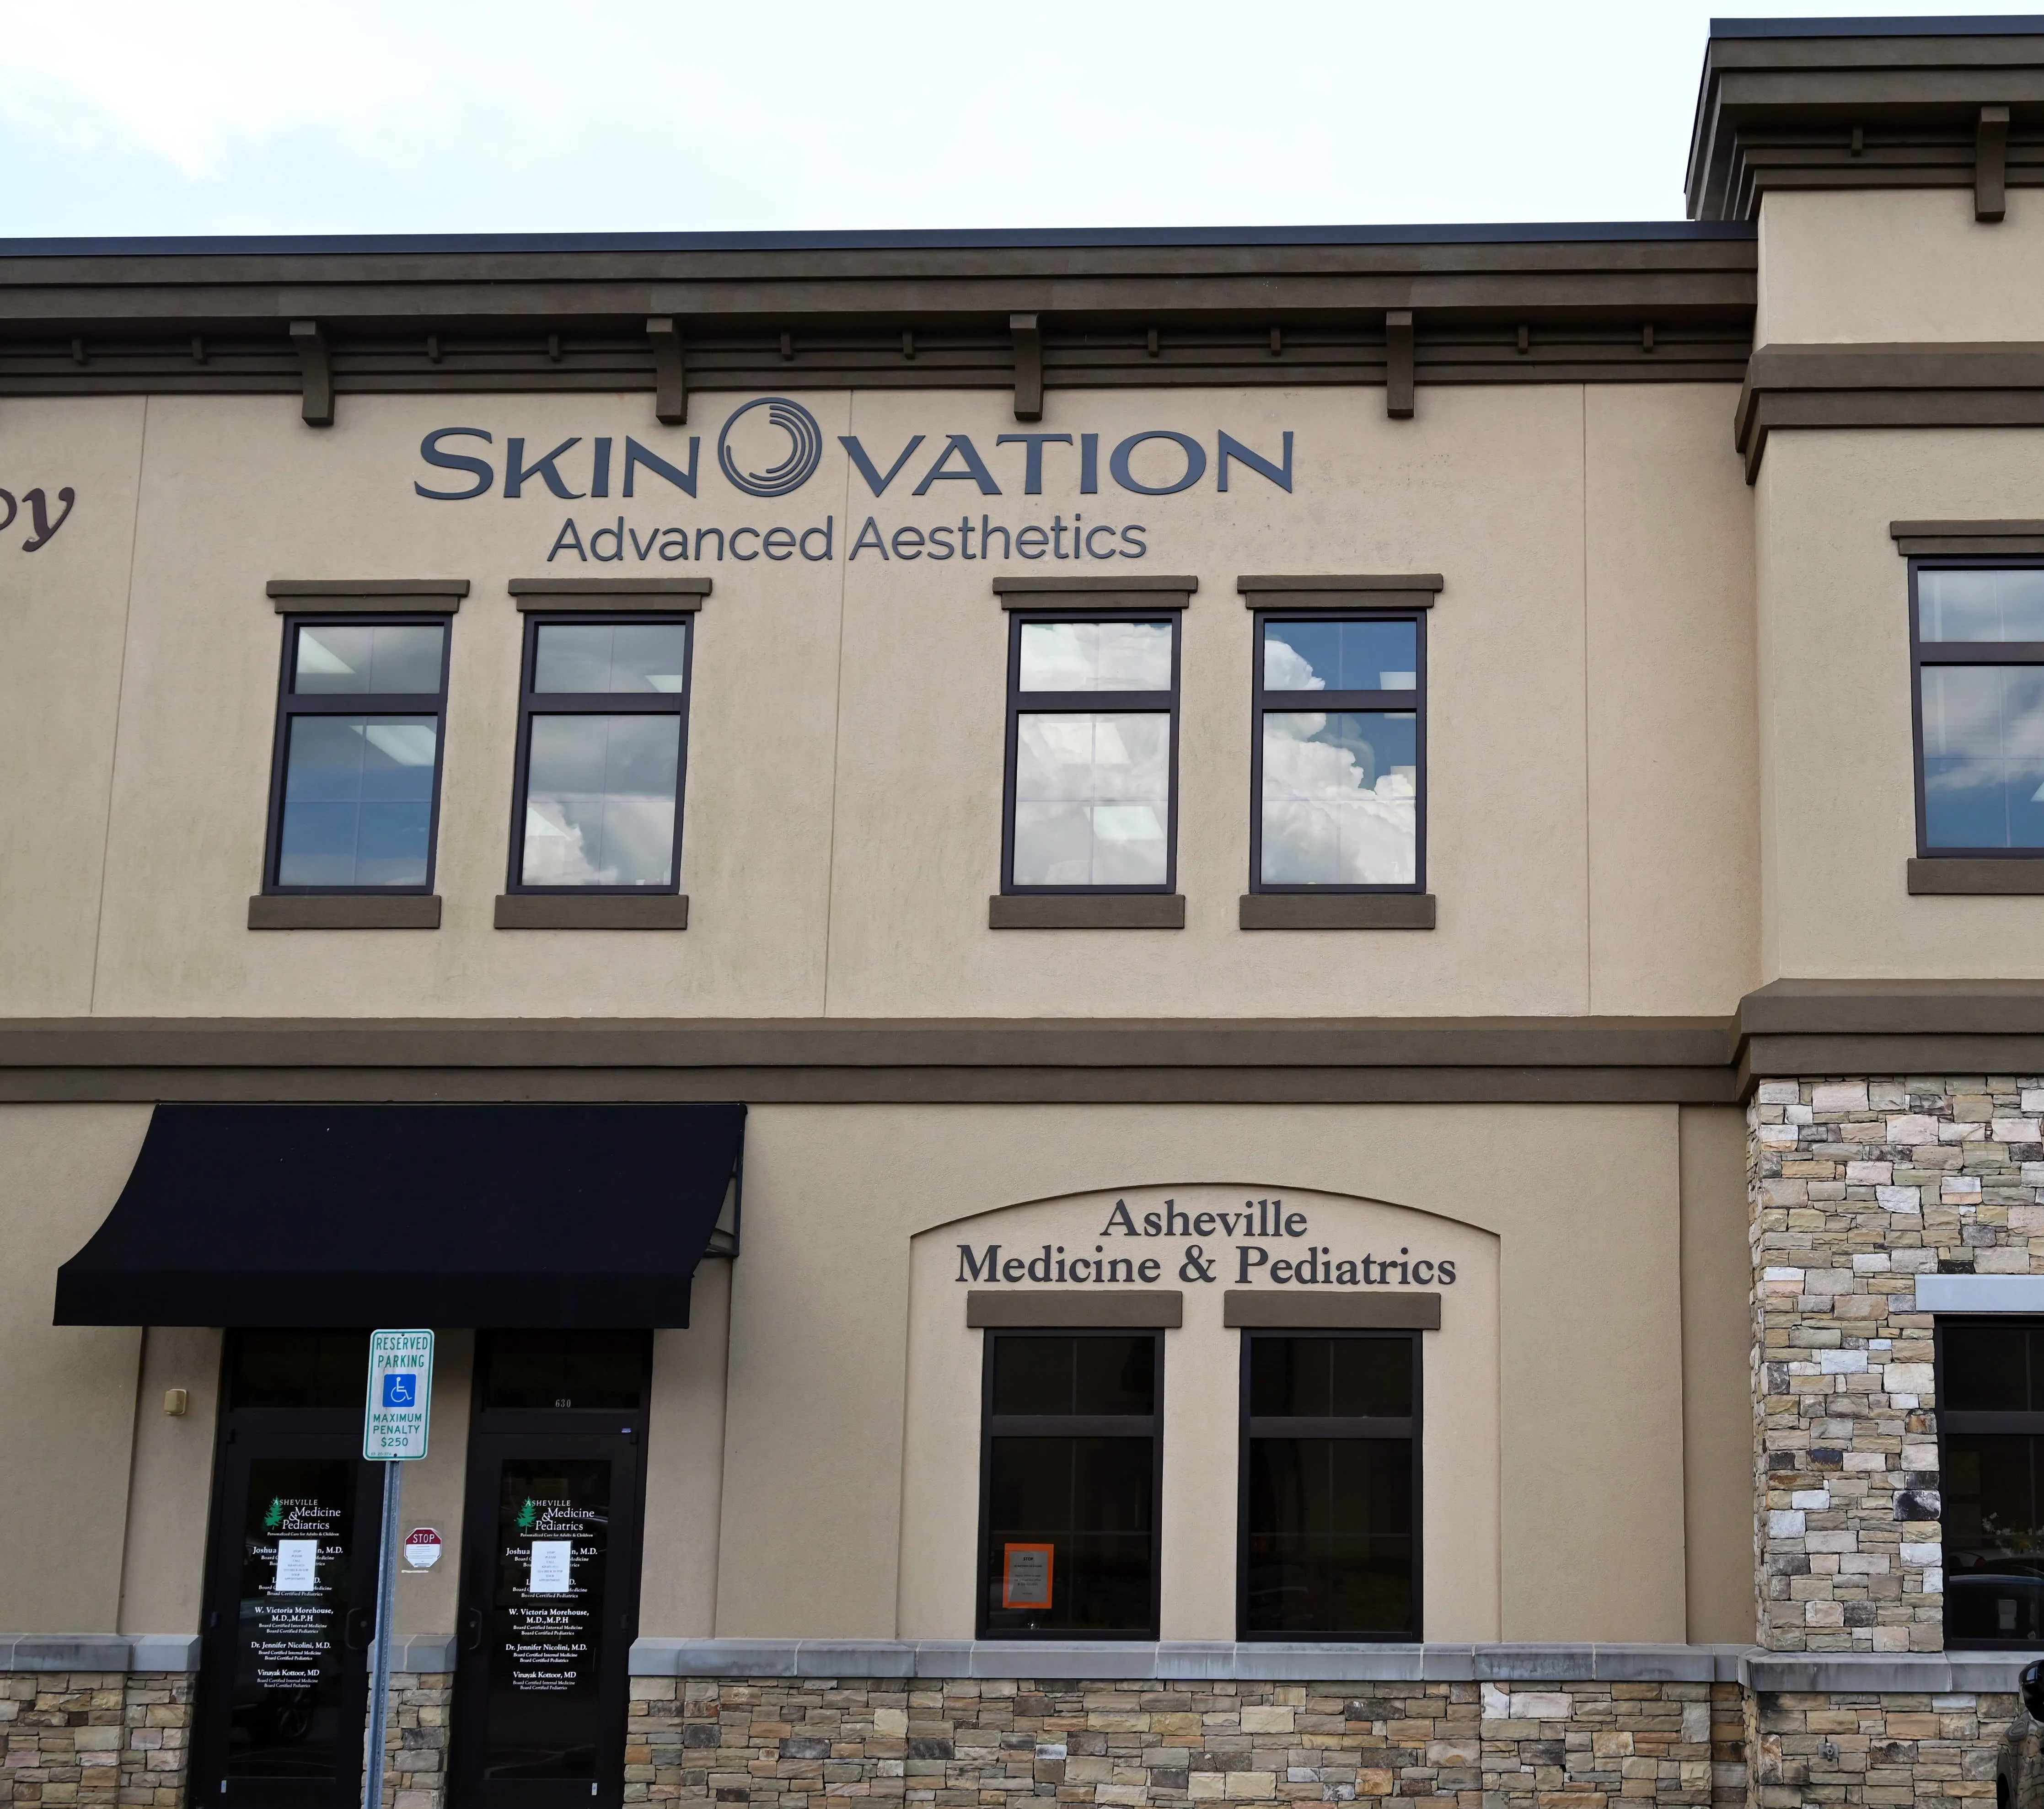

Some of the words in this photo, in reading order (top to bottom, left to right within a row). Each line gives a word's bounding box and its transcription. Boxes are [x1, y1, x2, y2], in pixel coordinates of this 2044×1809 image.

[547, 515, 833, 562] Advanced
[848, 513, 1147, 561] Aesthetics
[1100, 1199, 1307, 1237] Asheville
[955, 1245, 1160, 1283] Medicine
[1179, 1244, 1216, 1283] &
[1235, 1246, 1456, 1284] Pediatrics
[376, 1337, 428, 1350] RESERVED
[378, 1354, 424, 1368] PARKING
[555, 1399, 571, 1408] 630
[373, 1413, 422, 1423] MAXIMUM
[373, 1425, 420, 1434] PENALTY
[381, 1437, 408, 1447] $250
[289, 1512, 298, 1521] &
[295, 1507, 341, 1516] Medicine
[547, 1507, 595, 1517] Medicine
[542, 1513, 551, 1522] &
[282, 1520, 329, 1529] Pediatrics
[536, 1520, 583, 1531] Pediatrics
[413, 1534, 435, 1543] STOP
